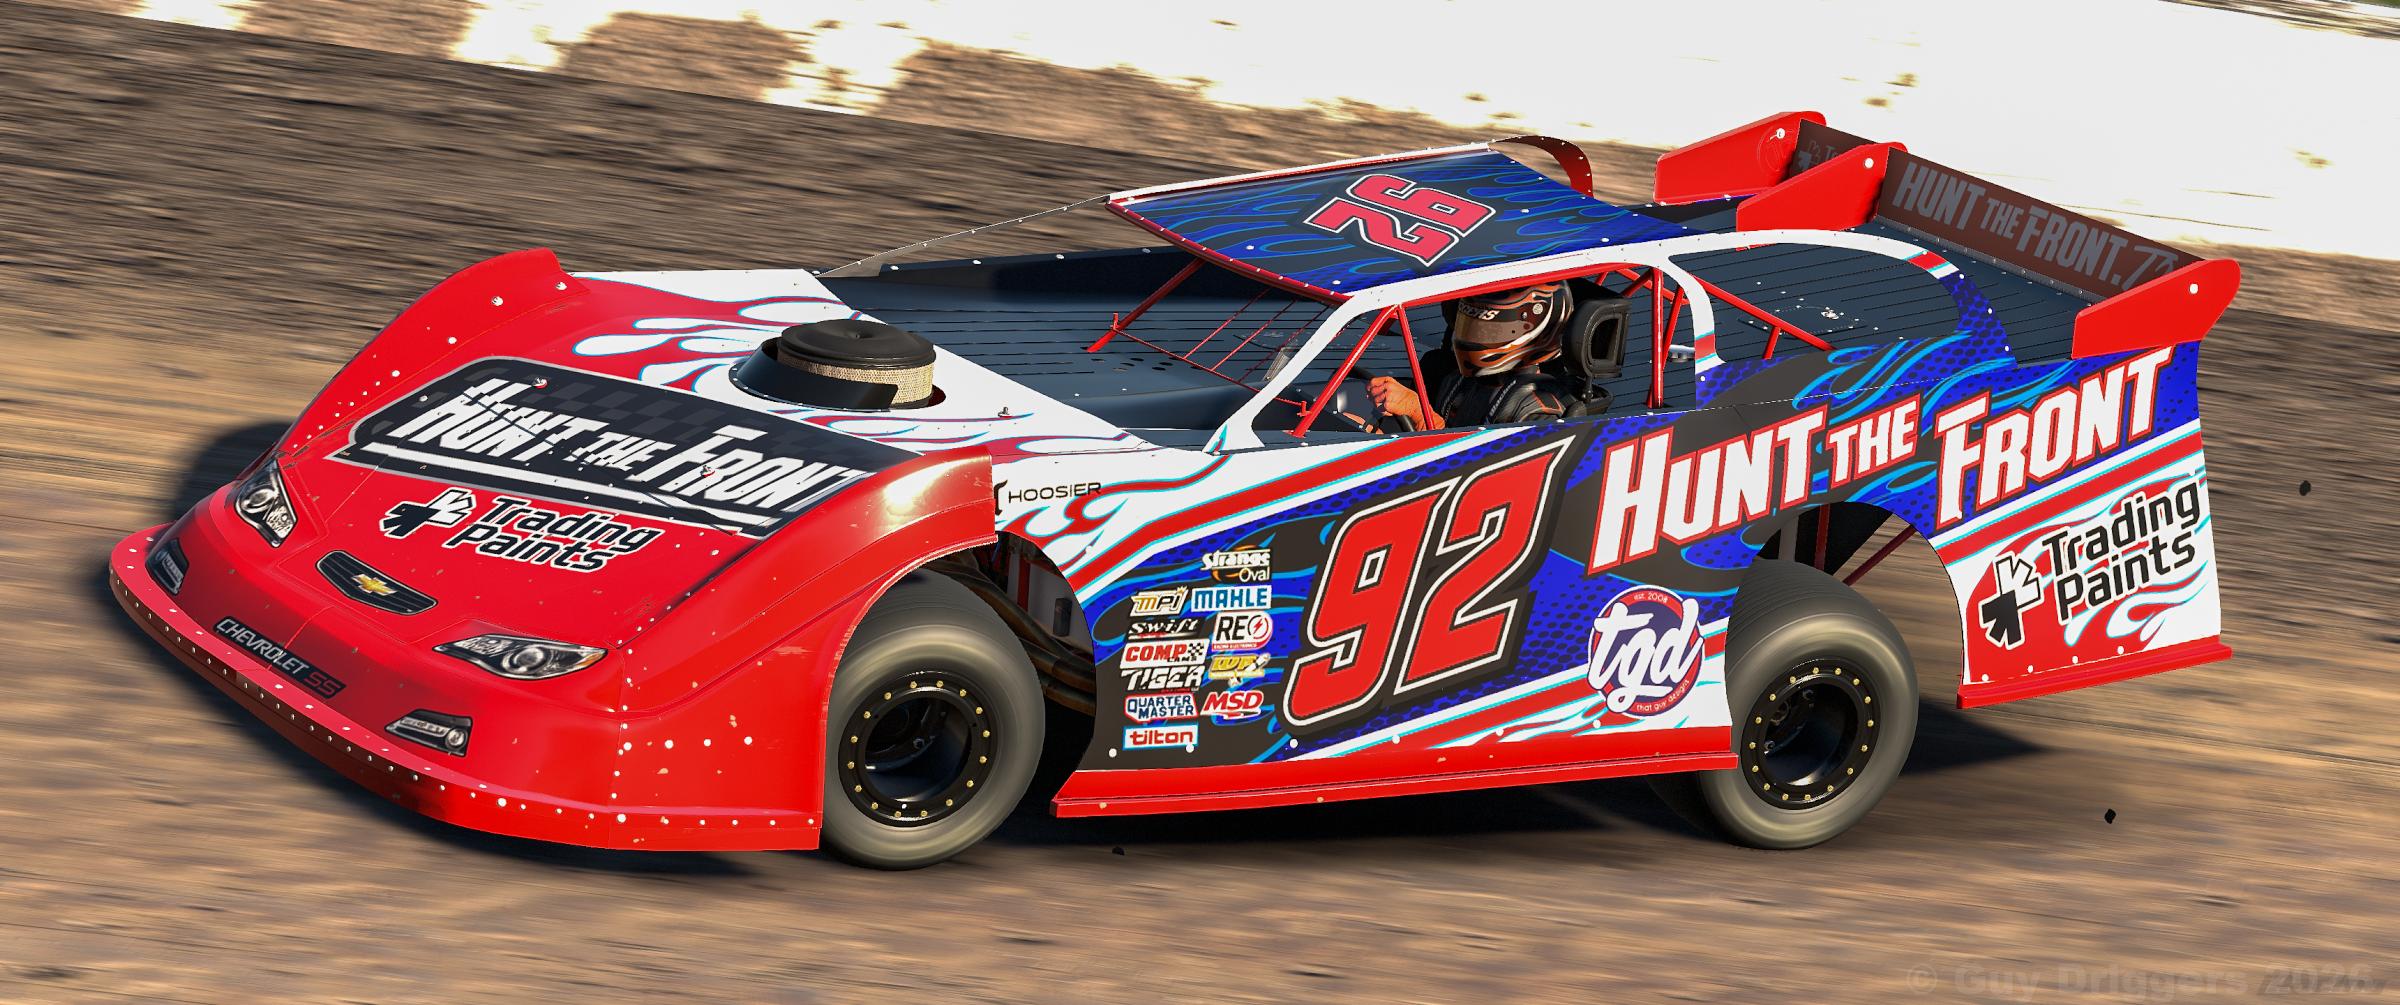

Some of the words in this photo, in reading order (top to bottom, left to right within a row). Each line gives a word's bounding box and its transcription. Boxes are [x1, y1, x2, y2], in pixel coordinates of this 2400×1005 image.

[1892, 161, 1986, 231] HUNT
[1980, 197, 2024, 240] THE
[386, 377, 610, 463] HUNT
[572, 434, 677, 472] THE
[1585, 404, 1829, 576] HUNT
[1825, 393, 1921, 489] THE
[1933, 345, 2175, 530] FRONT
[1008, 482, 1102, 504] HOOSIER
[447, 523, 614, 570] Paints
[479, 496, 662, 552] Trading
[2042, 482, 2201, 576] Trading
[1239, 567, 1270, 582] Oval
[1283, 434, 1577, 726] 92
[2057, 531, 2196, 621] Paints
[1195, 588, 1267, 609] MAHLE
[216, 618, 309, 675] CHEVROLET
[303, 671, 343, 696] SS
[1125, 644, 1187, 662] COMP
[1588, 598, 1703, 713] tgd
[1121, 665, 1205, 690] TIGER
[1127, 695, 1192, 714] QUARTER
[1138, 705, 1194, 720] MASTER
[1203, 691, 1263, 712] MSD
[1129, 729, 1194, 746] tilton
